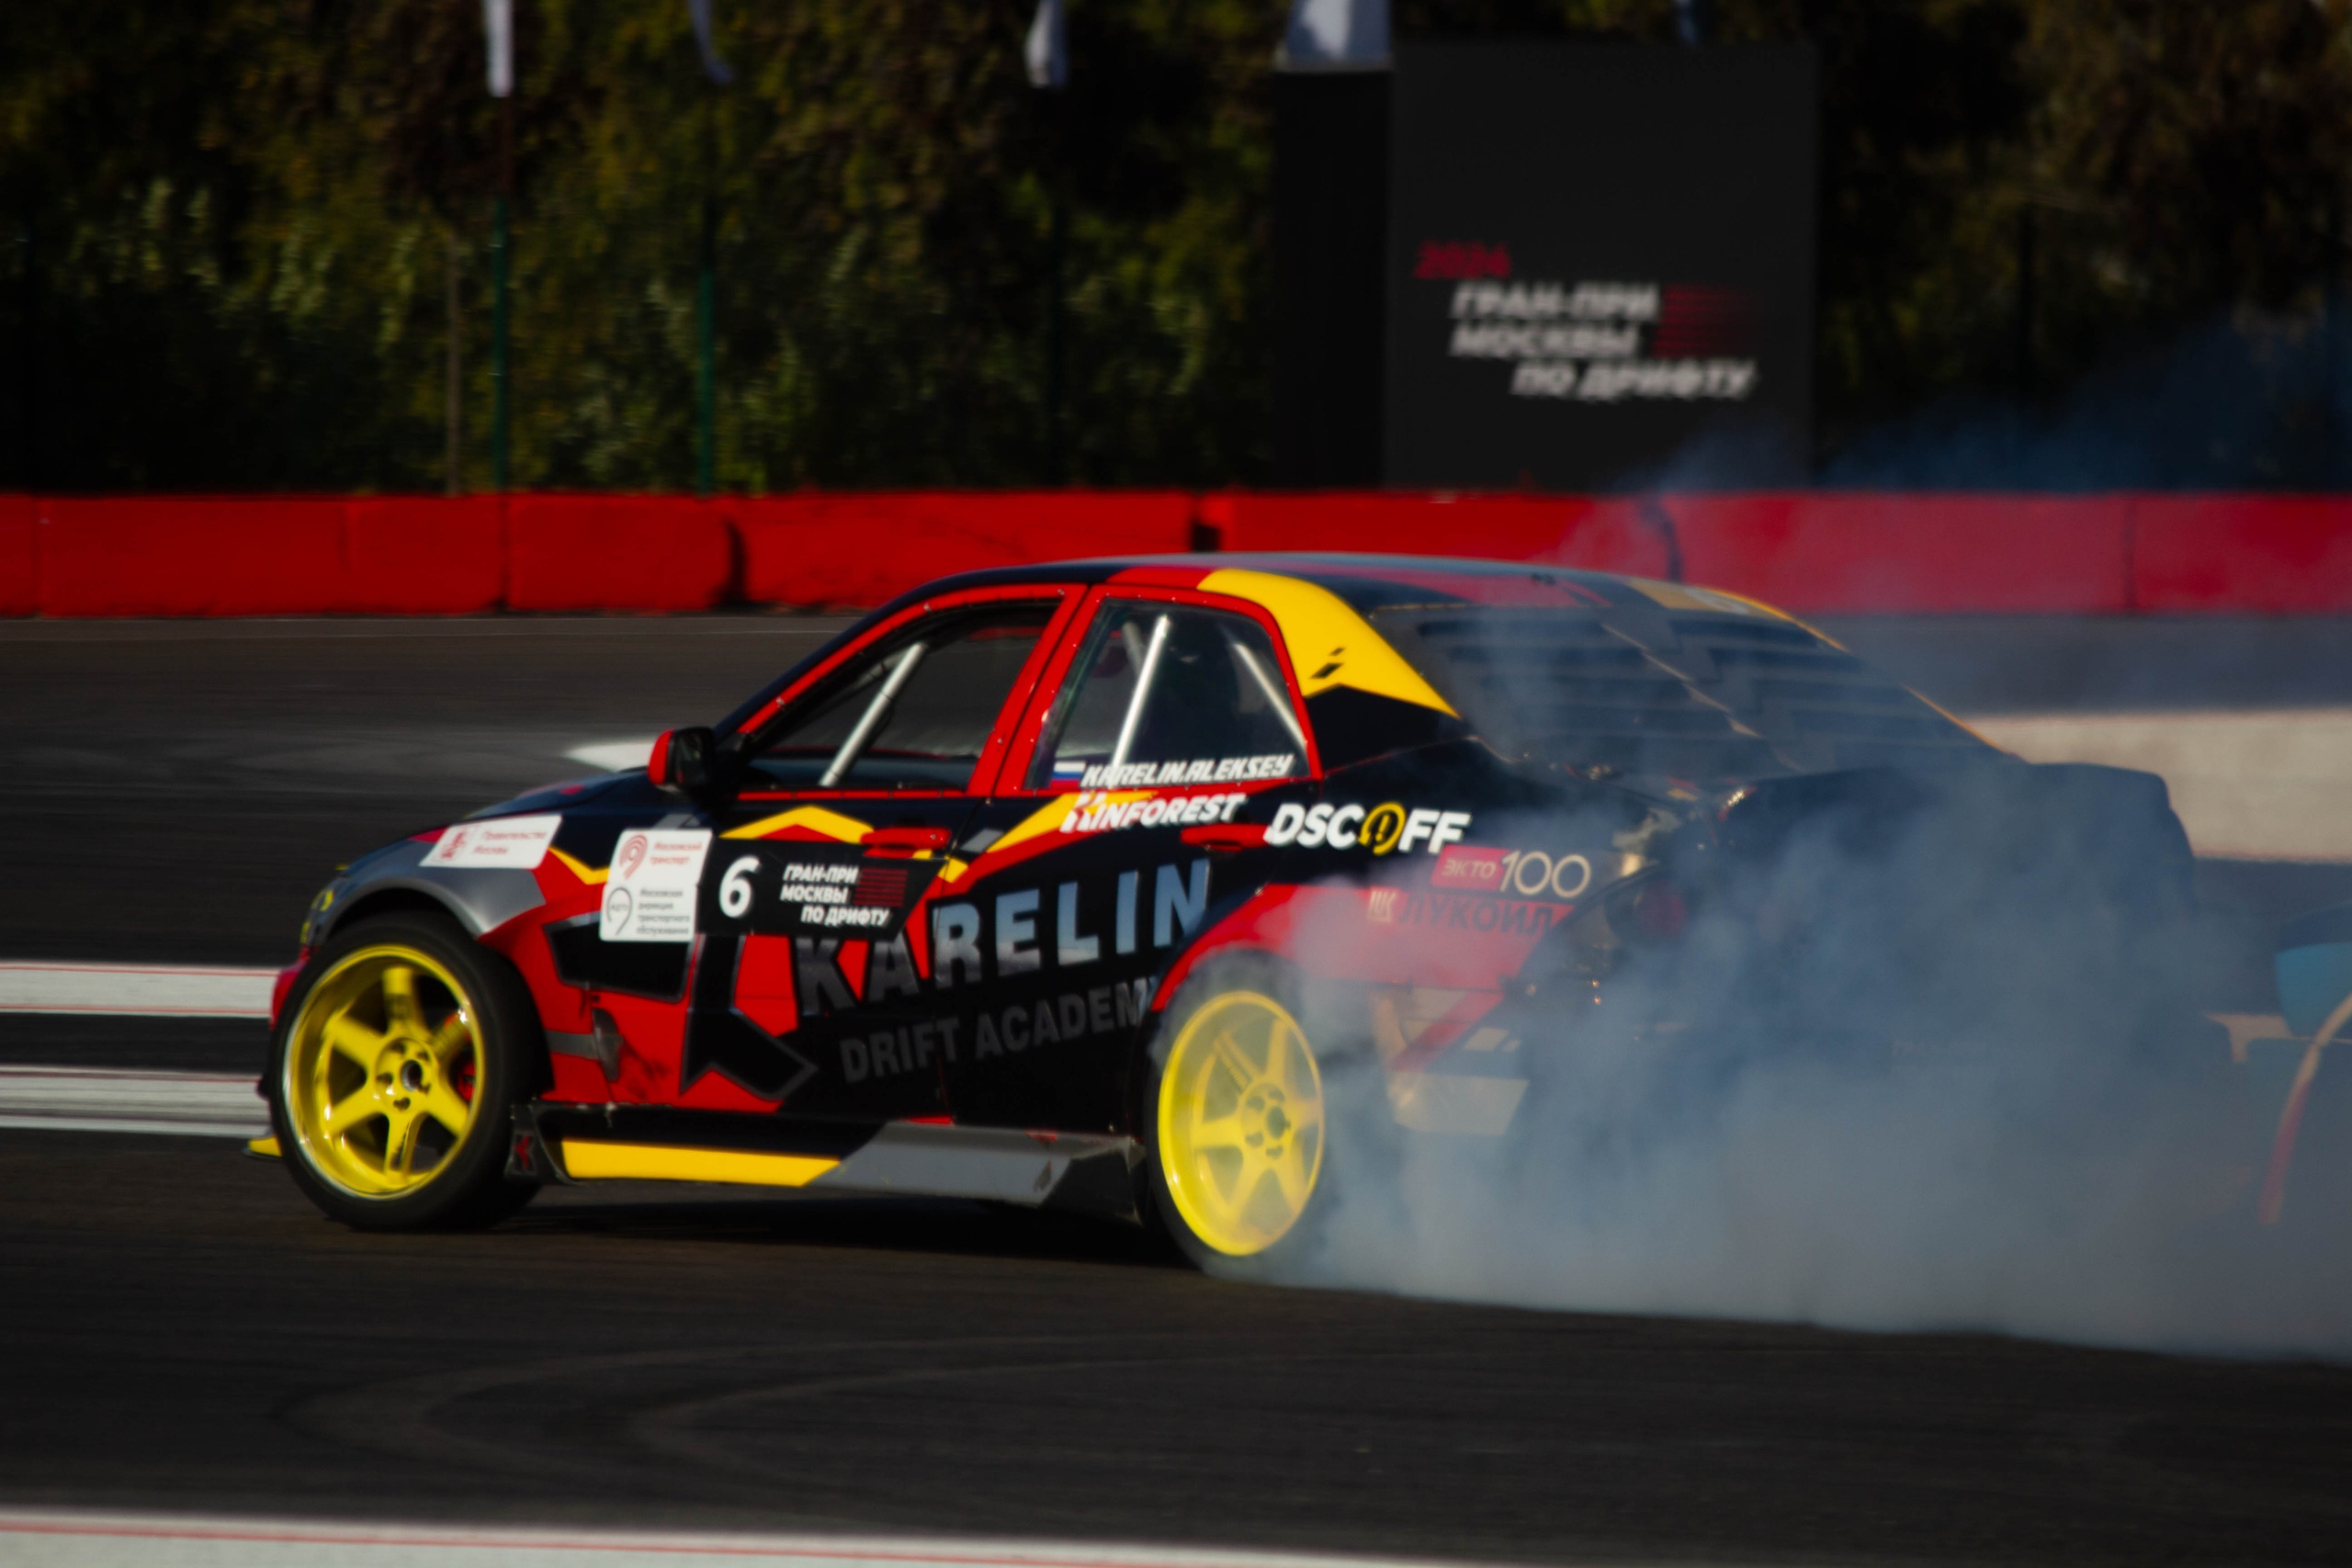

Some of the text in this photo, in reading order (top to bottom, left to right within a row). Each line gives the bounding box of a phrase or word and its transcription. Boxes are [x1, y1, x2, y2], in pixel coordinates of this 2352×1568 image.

[1449, 281, 1660, 321] ГРАН-ПРИ
[1449, 323, 1641, 357] МОСКВЫ
[1510, 361, 1758, 401] ПО ДРИФТУ
[719, 855, 760, 918] 6
[783, 864, 859, 885] ГРАН-ПРИ
[1498, 850, 1592, 898] 100
[780, 885, 848, 905] МОСКВЫ
[800, 905, 890, 927] ПО ДРИФТУ
[794, 857, 1211, 1018] KARELIN
[839, 1016, 962, 1084] DRIFT
